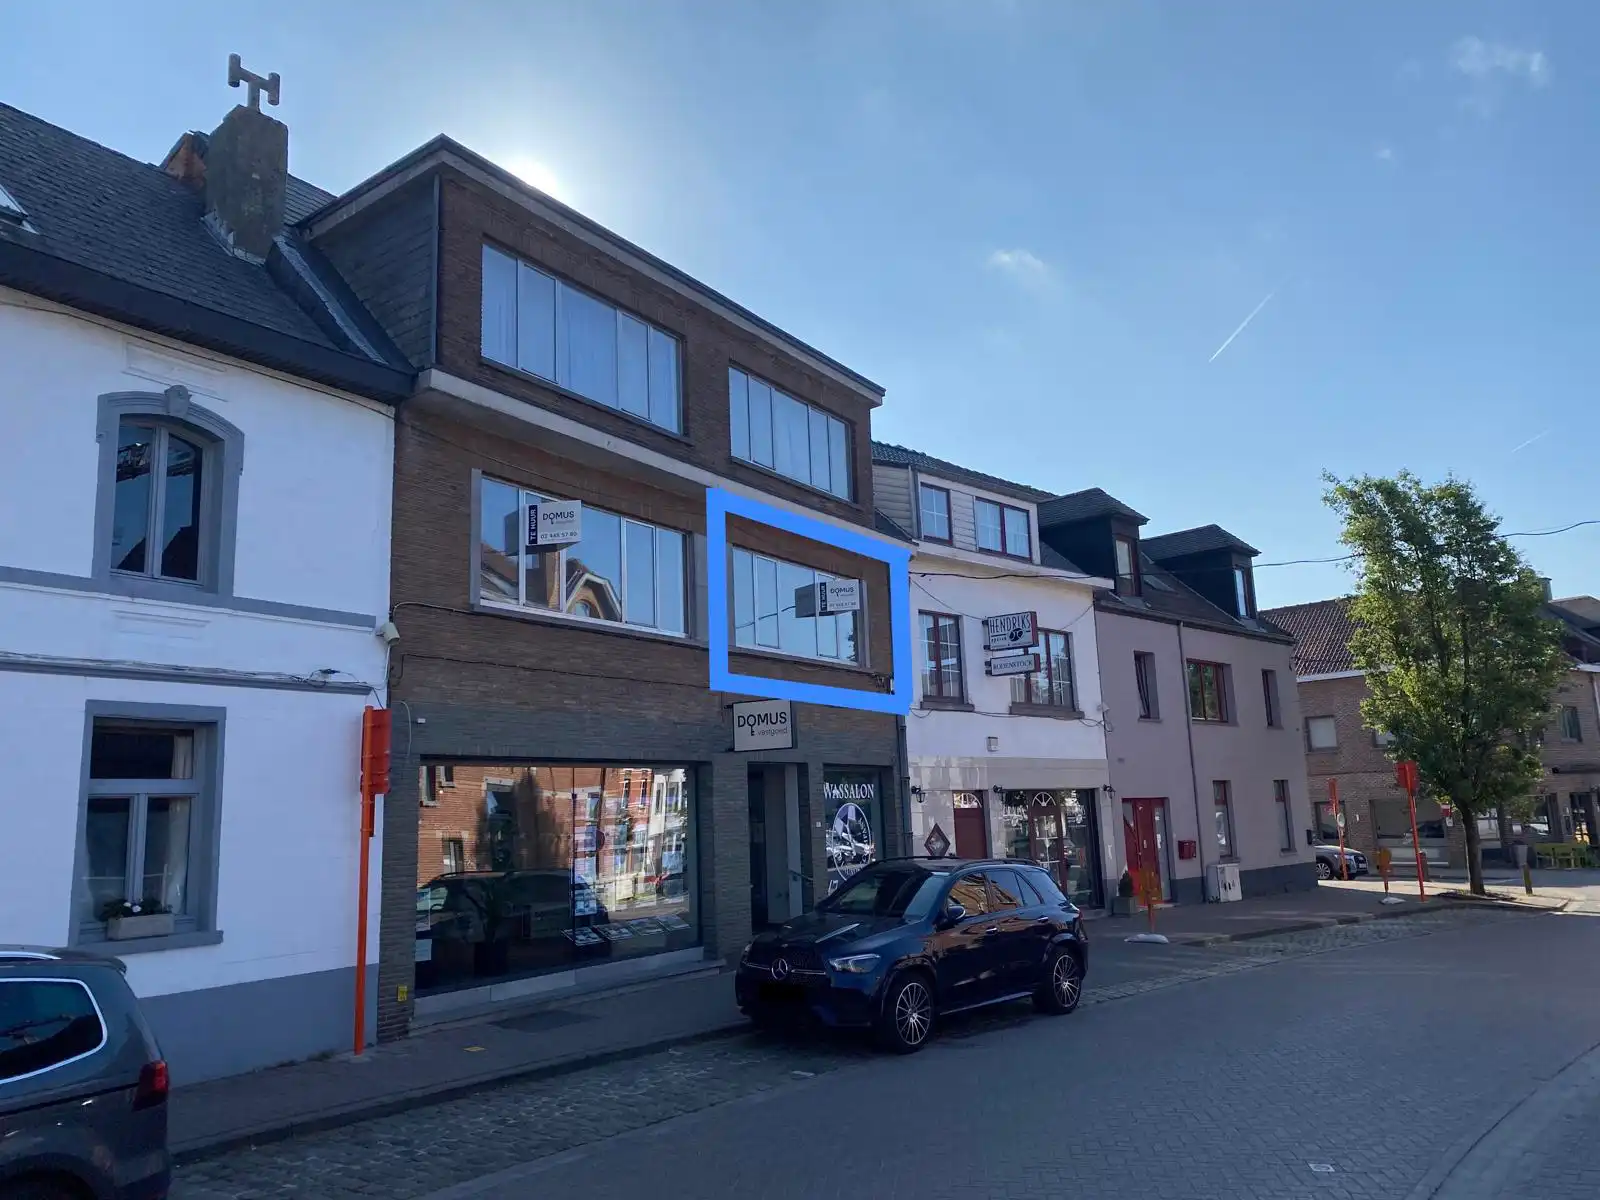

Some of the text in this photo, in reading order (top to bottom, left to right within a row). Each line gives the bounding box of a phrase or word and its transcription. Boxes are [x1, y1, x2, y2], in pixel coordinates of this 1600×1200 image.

[542, 511, 575, 521] DOMUS
[530, 531, 537, 541] TE
[830, 586, 855, 594] DOMUS
[989, 613, 1031, 634] HENDRIKS
[737, 711, 787, 728] DOMUS
[823, 782, 875, 800] WASSALON
